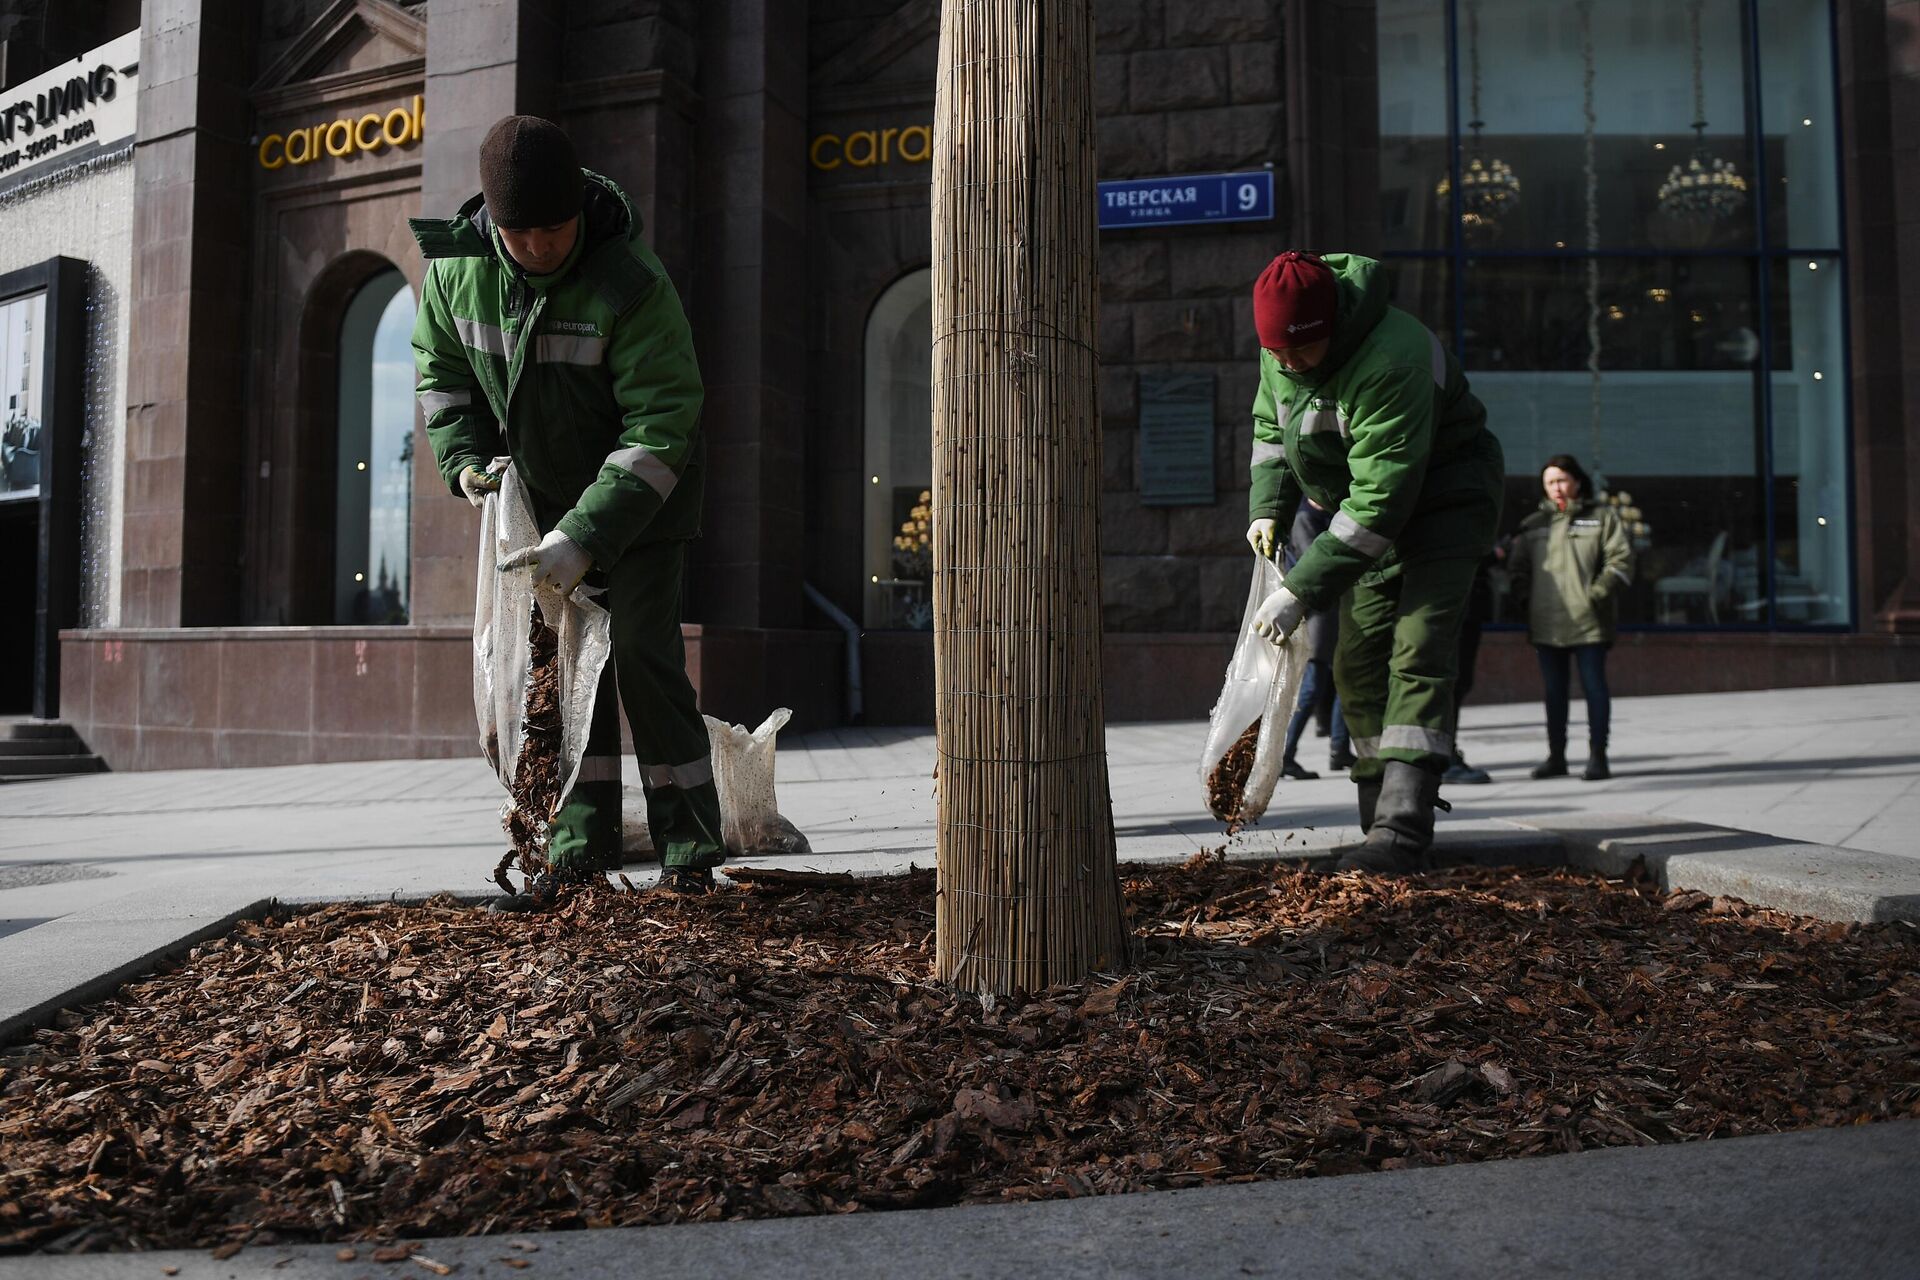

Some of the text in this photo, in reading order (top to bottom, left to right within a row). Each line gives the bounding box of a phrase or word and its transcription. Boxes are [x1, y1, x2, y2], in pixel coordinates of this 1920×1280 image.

[35, 63, 117, 129] LIVING
[259, 94, 426, 169] caracol
[1104, 183, 1258, 211] ТВЕРСКАЯ 9
